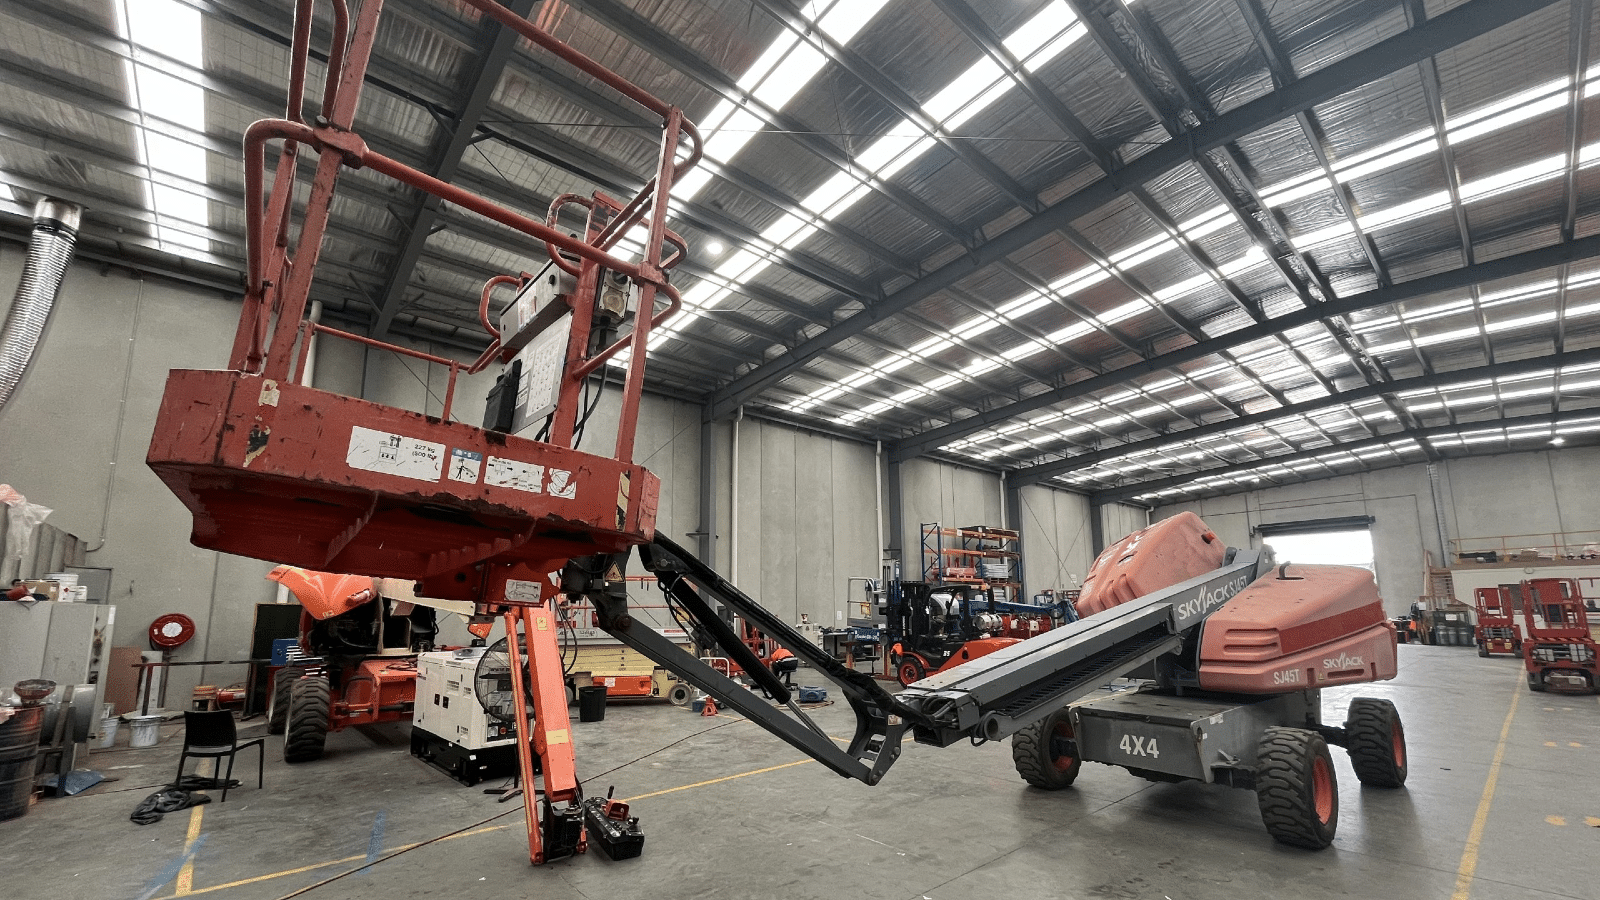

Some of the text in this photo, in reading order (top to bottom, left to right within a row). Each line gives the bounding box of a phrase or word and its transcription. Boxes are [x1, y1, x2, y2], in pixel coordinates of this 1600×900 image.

[1178, 584, 1230, 620] SKYJACK
[1323, 652, 1365, 669] SKYJACK
[1273, 669, 1300, 685] SJ45T
[1119, 734, 1160, 759] 4X4
